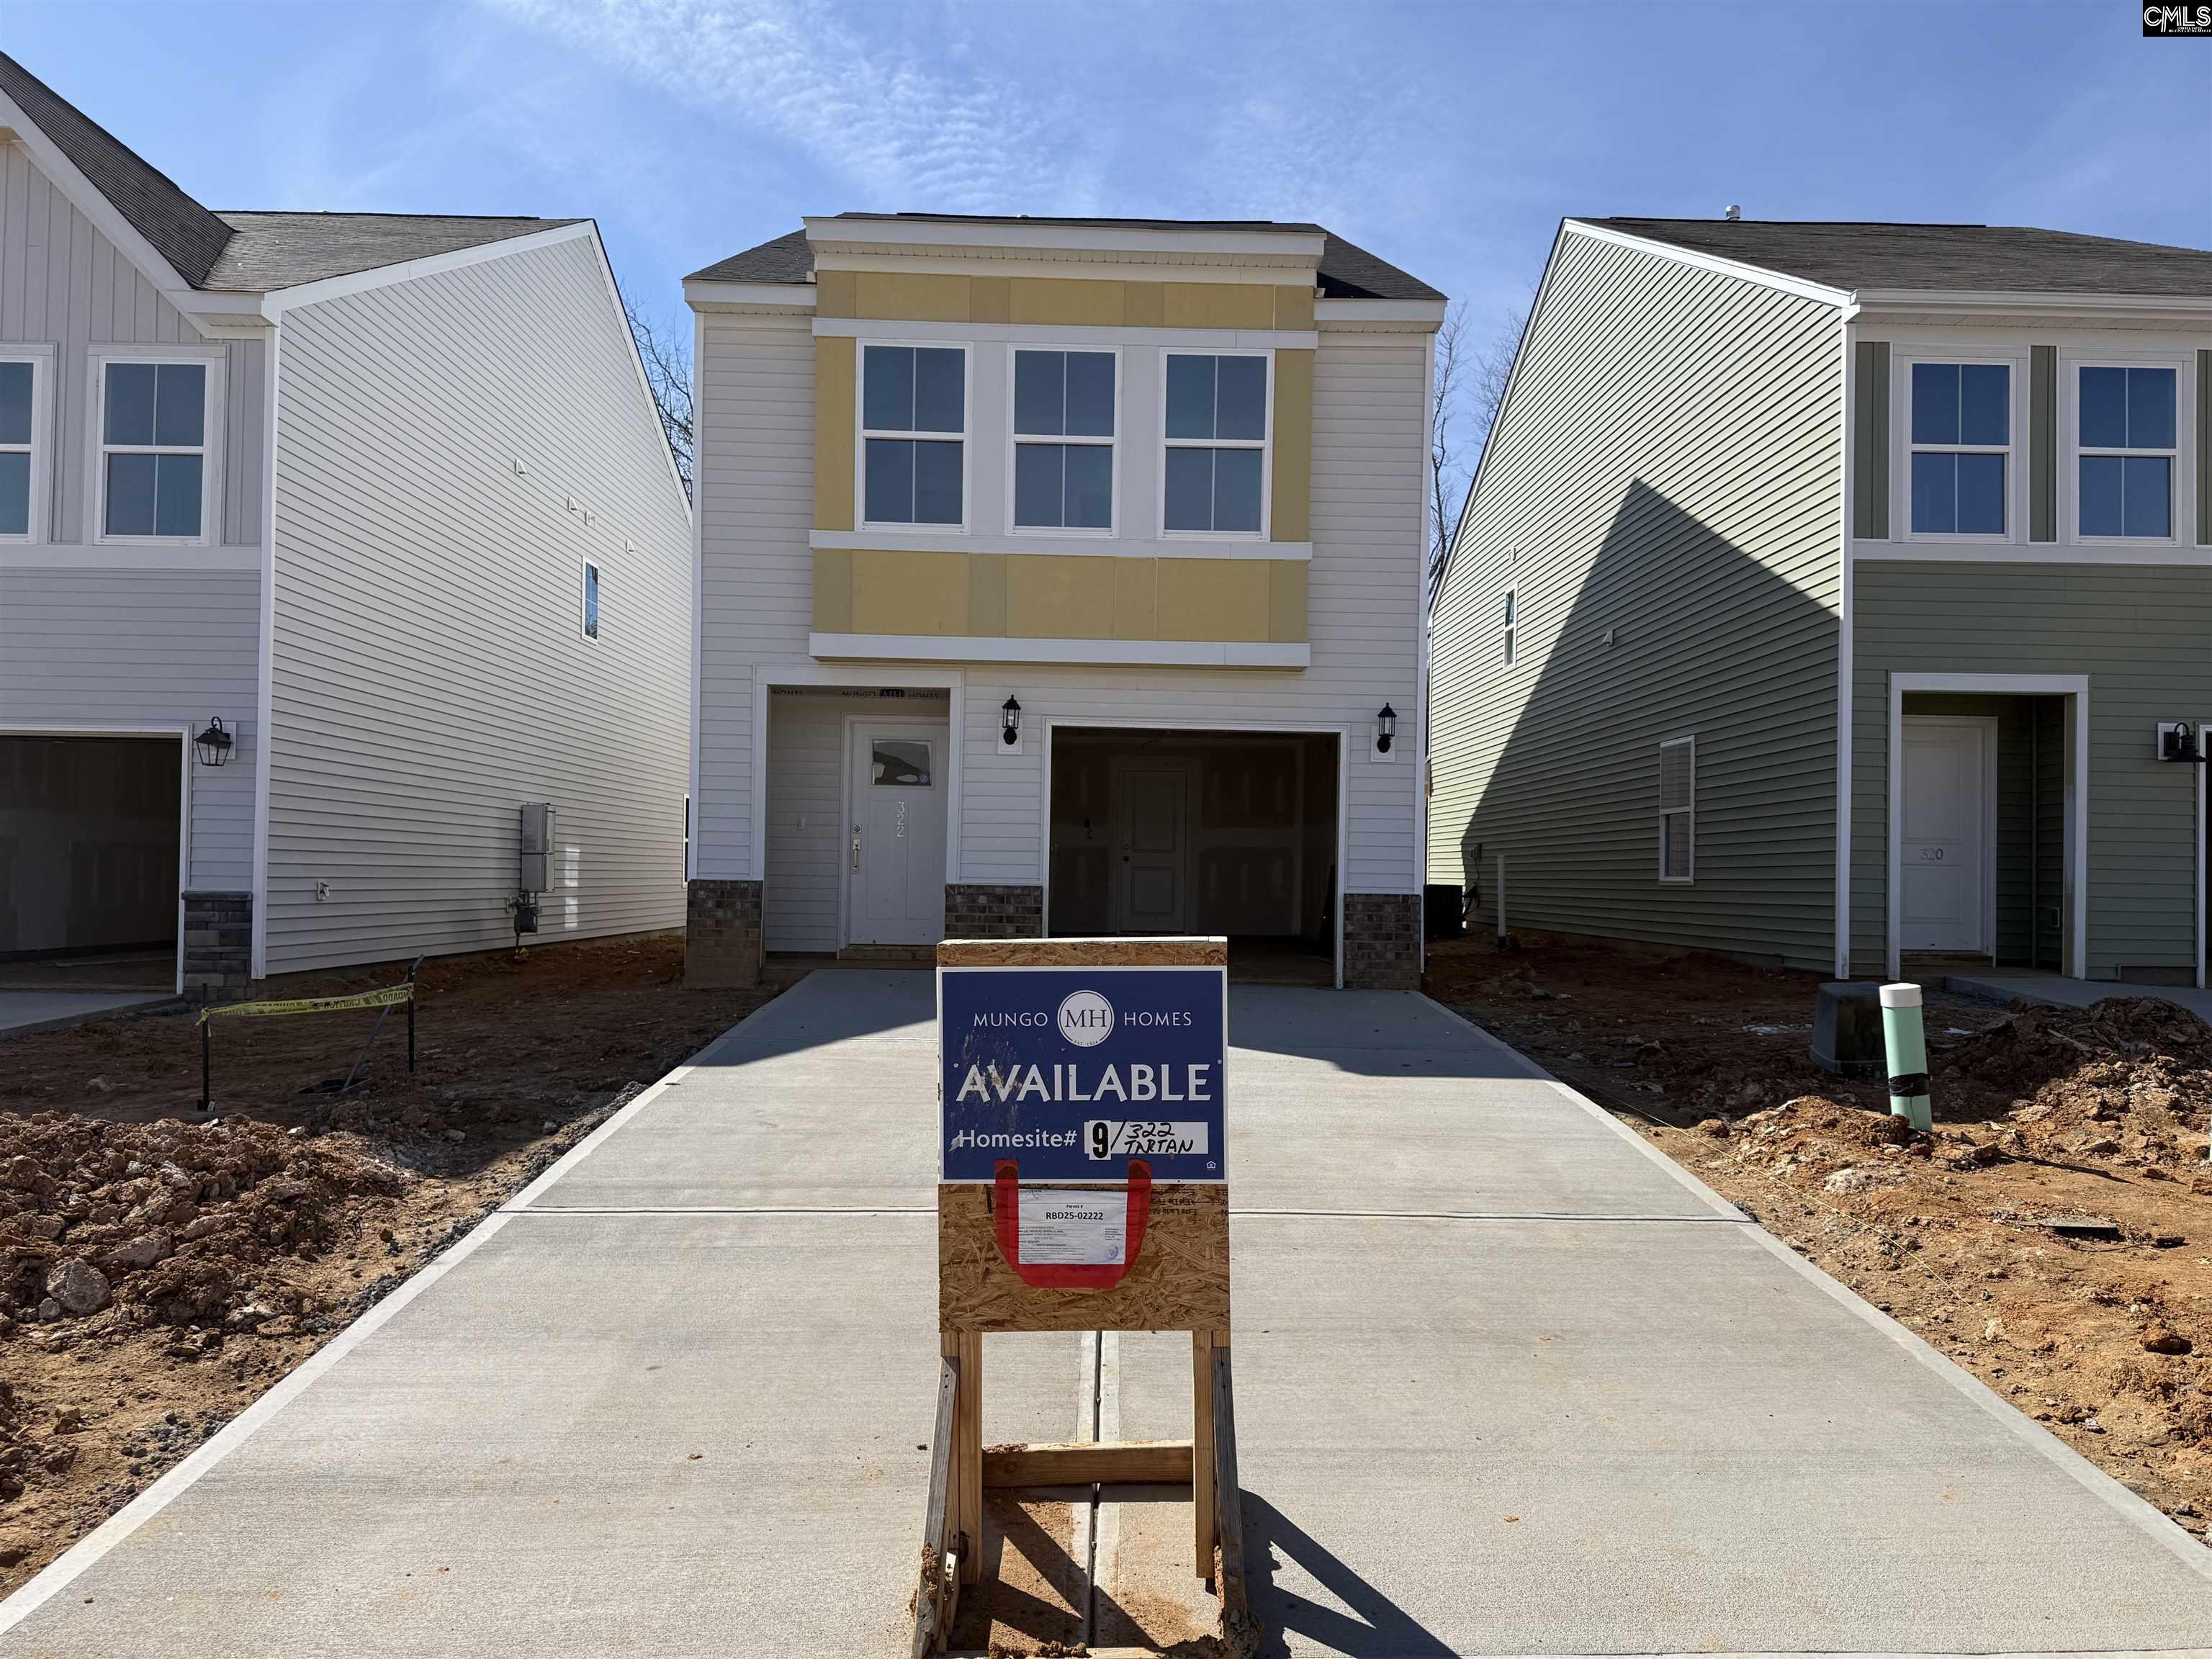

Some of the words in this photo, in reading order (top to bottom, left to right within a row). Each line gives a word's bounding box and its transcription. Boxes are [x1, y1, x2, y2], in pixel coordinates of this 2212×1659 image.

[1918, 848, 1944, 860] 320
[974, 1012, 1048, 1028] MUNGO
[1064, 1009, 1107, 1028] MH
[1124, 1012, 1192, 1027] HOMES
[956, 1064, 1212, 1103] AVAILABLE
[958, 1128, 1077, 1148] Homesite#
[1124, 1138, 1194, 1155] TARTAN
[1046, 1211, 1104, 1220] RBD25-02222
